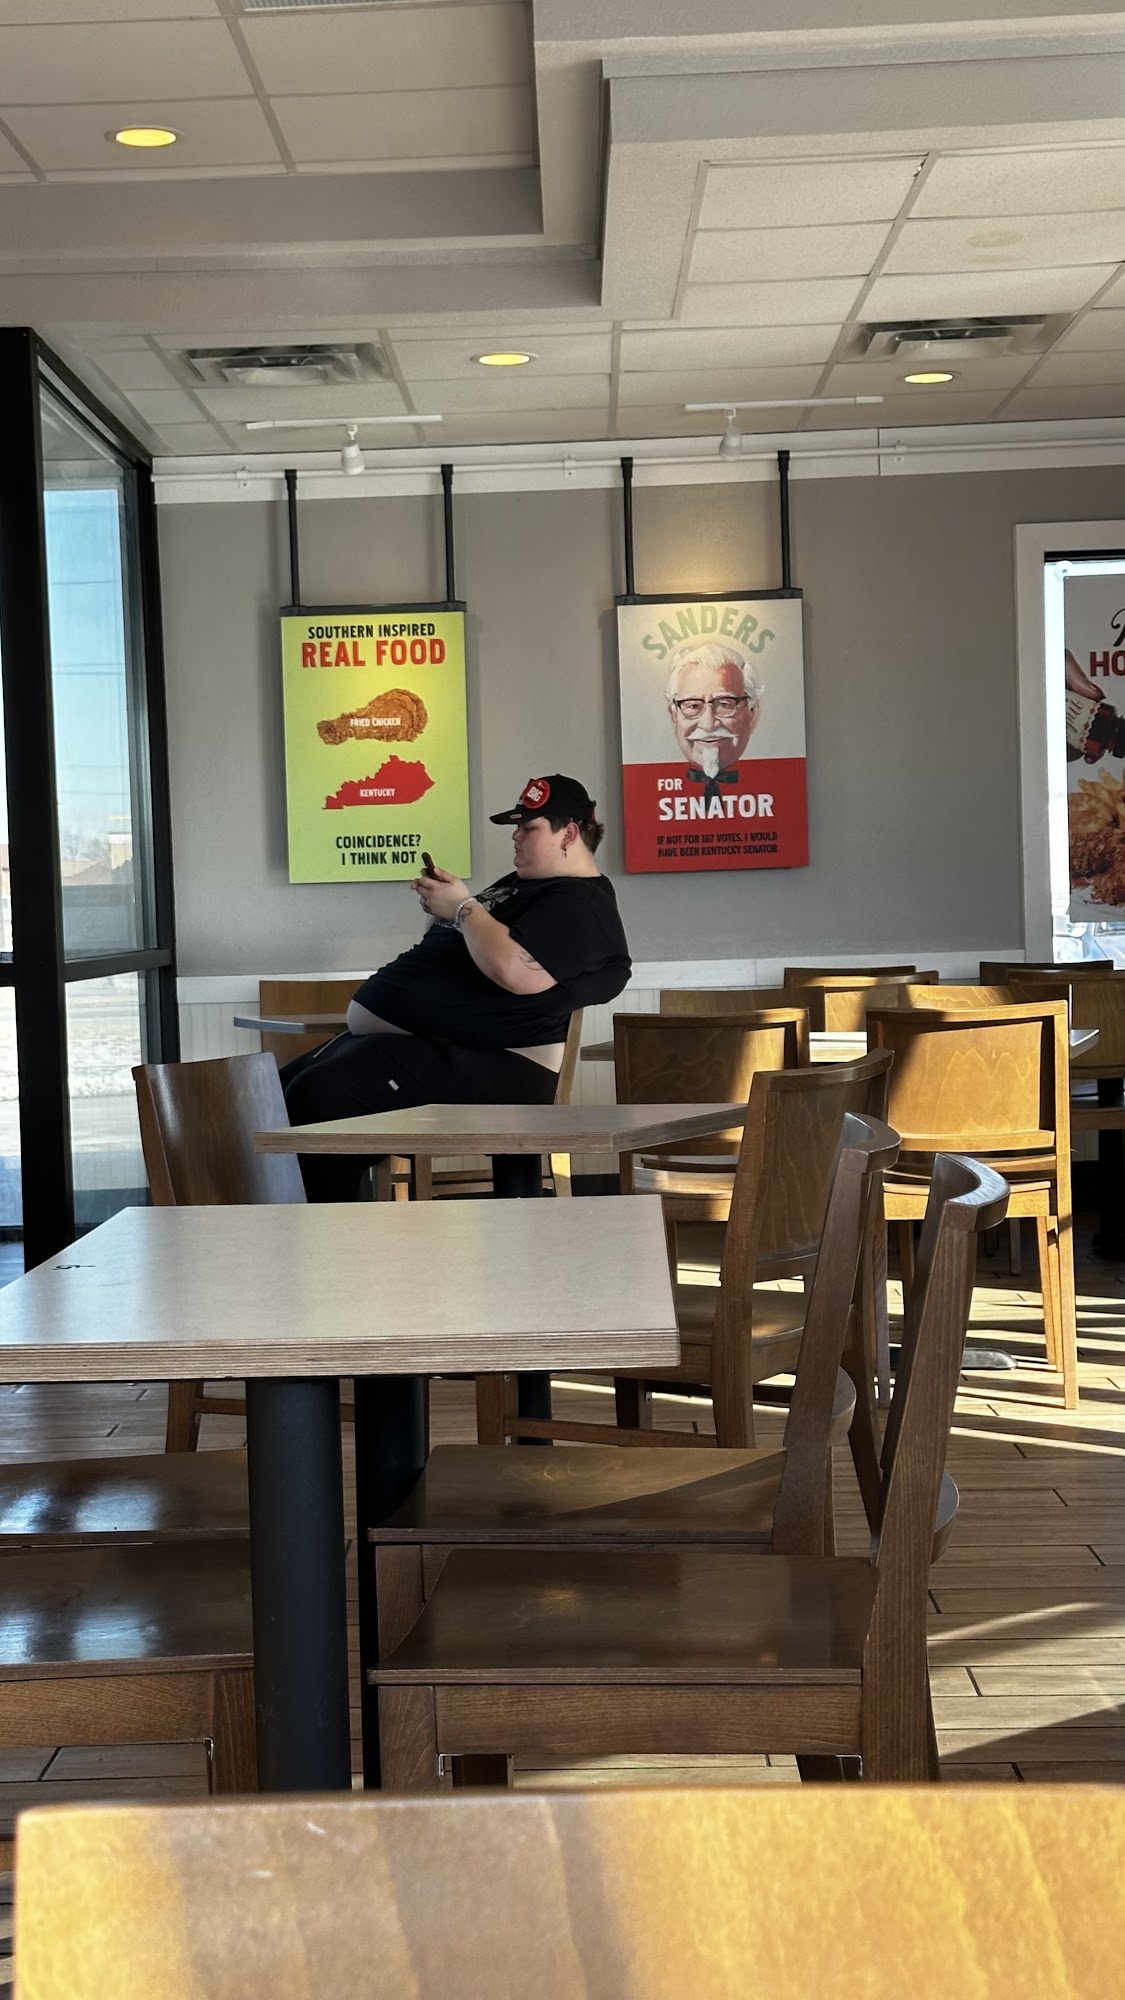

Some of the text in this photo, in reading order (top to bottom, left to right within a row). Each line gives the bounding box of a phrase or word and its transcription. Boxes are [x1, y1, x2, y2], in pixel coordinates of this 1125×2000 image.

[308, 623, 435, 639] SOUTHERN INSPIRED
[642, 605, 775, 660] SANDERS
[302, 639, 446, 668] REAL FOOD
[350, 717, 401, 727] FRIED CHICKEN
[657, 778, 683, 791] FOR
[360, 788, 396, 797] KENTUCKY
[527, 786, 543, 802] BIG
[658, 794, 774, 821] SENATOR
[336, 834, 421, 849] COINCIDENCE?
[657, 836, 664, 845] IF
[666, 835, 682, 844] NOT
[684, 834, 700, 844] FOR
[749, 832, 778, 841] WOULD
[658, 844, 778, 857] HAVE BEEN KENTUCKY SENATOR
[341, 851, 417, 865] I THINK NOT
